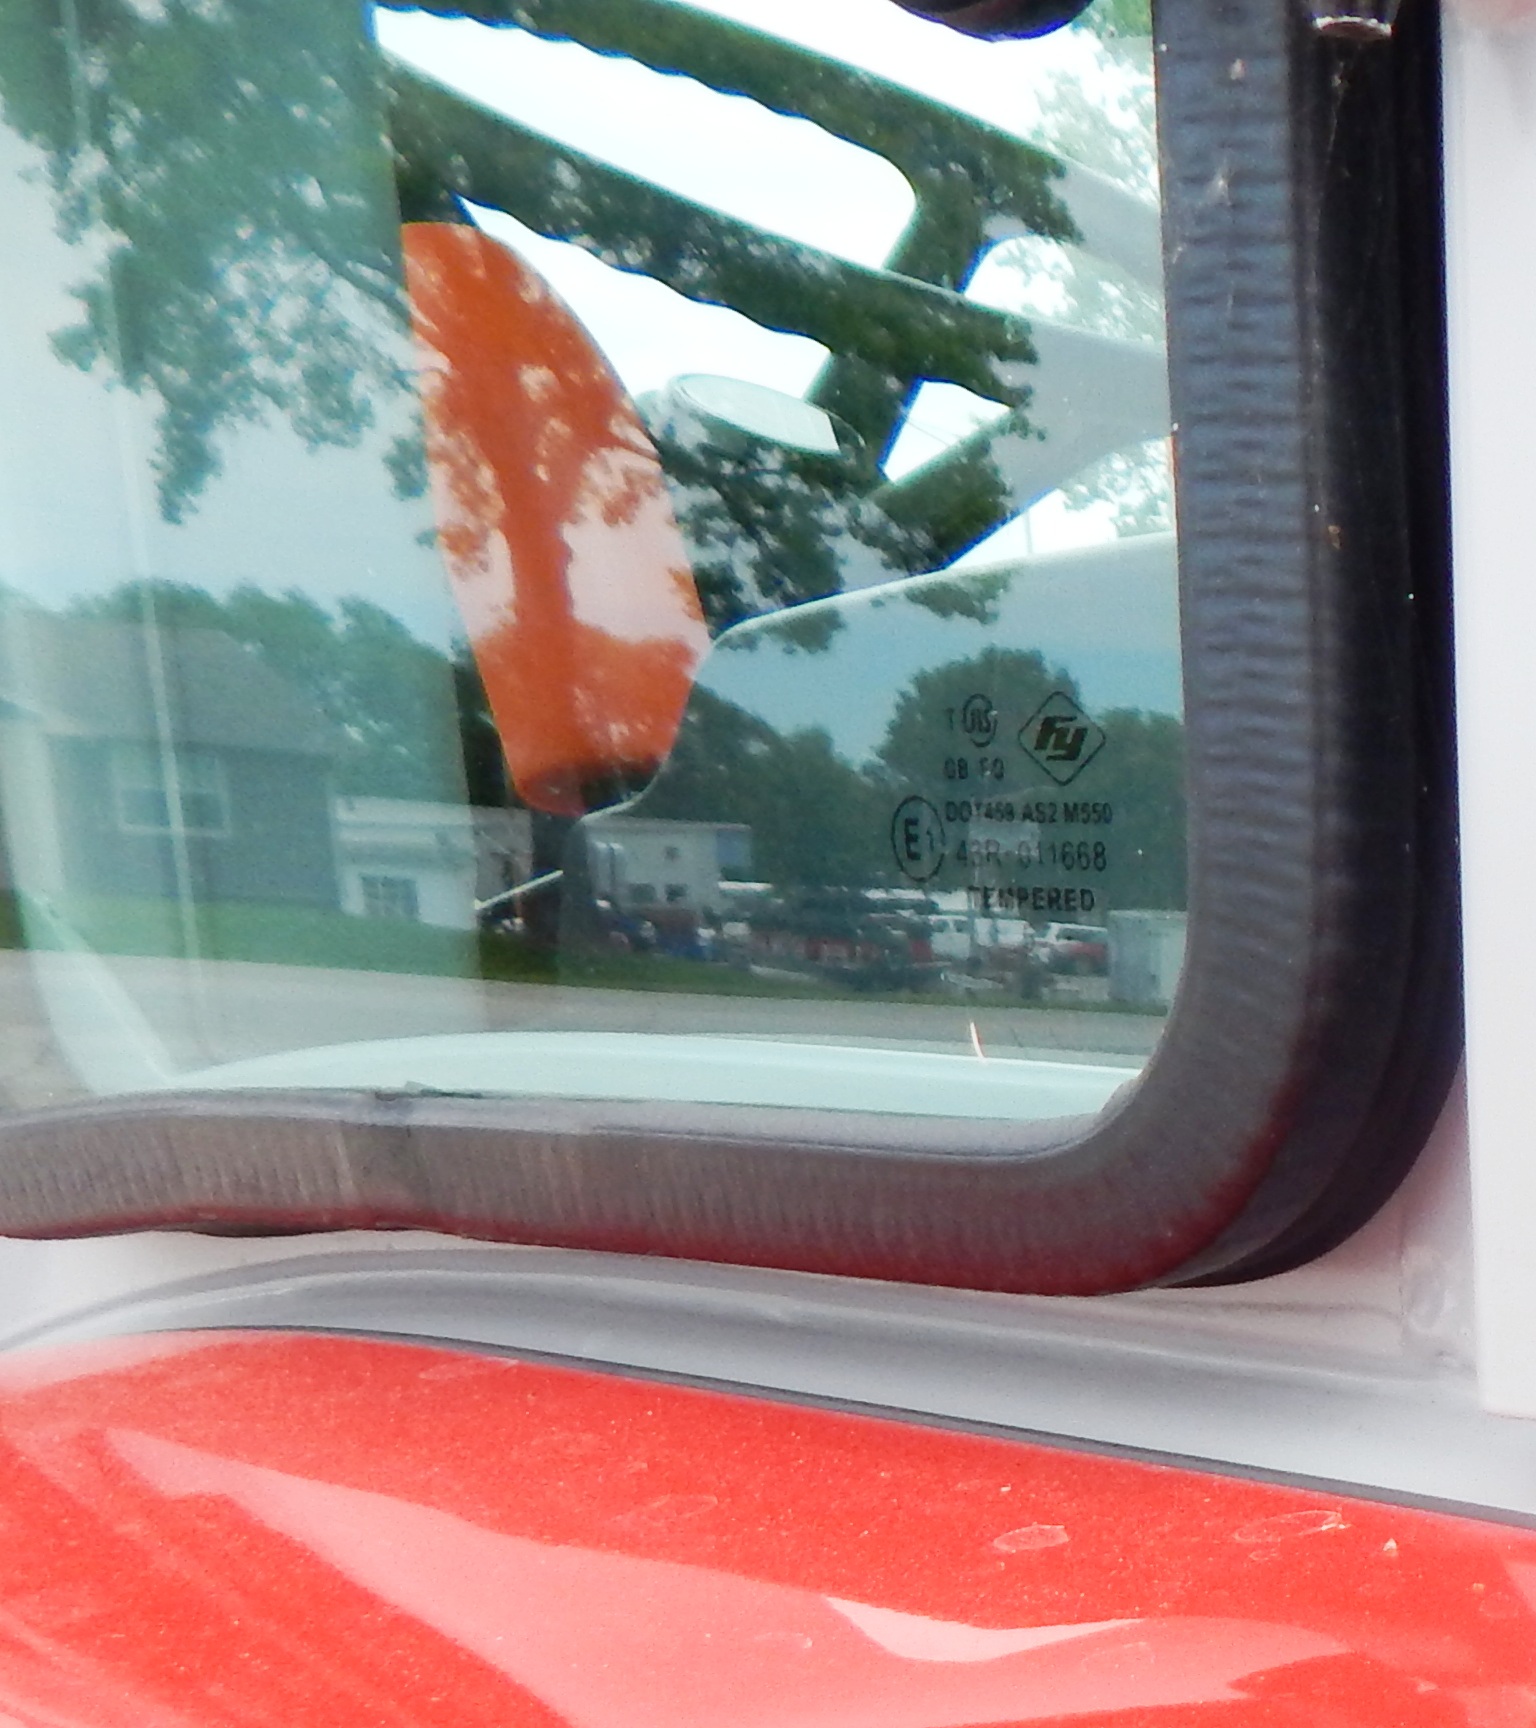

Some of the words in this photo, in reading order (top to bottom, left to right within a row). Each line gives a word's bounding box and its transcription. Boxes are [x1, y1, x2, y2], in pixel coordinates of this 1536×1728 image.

[1021, 802, 1057, 824] AS2
[1063, 802, 1113, 824] M550
[967, 885, 1095, 912] TEMPERED
